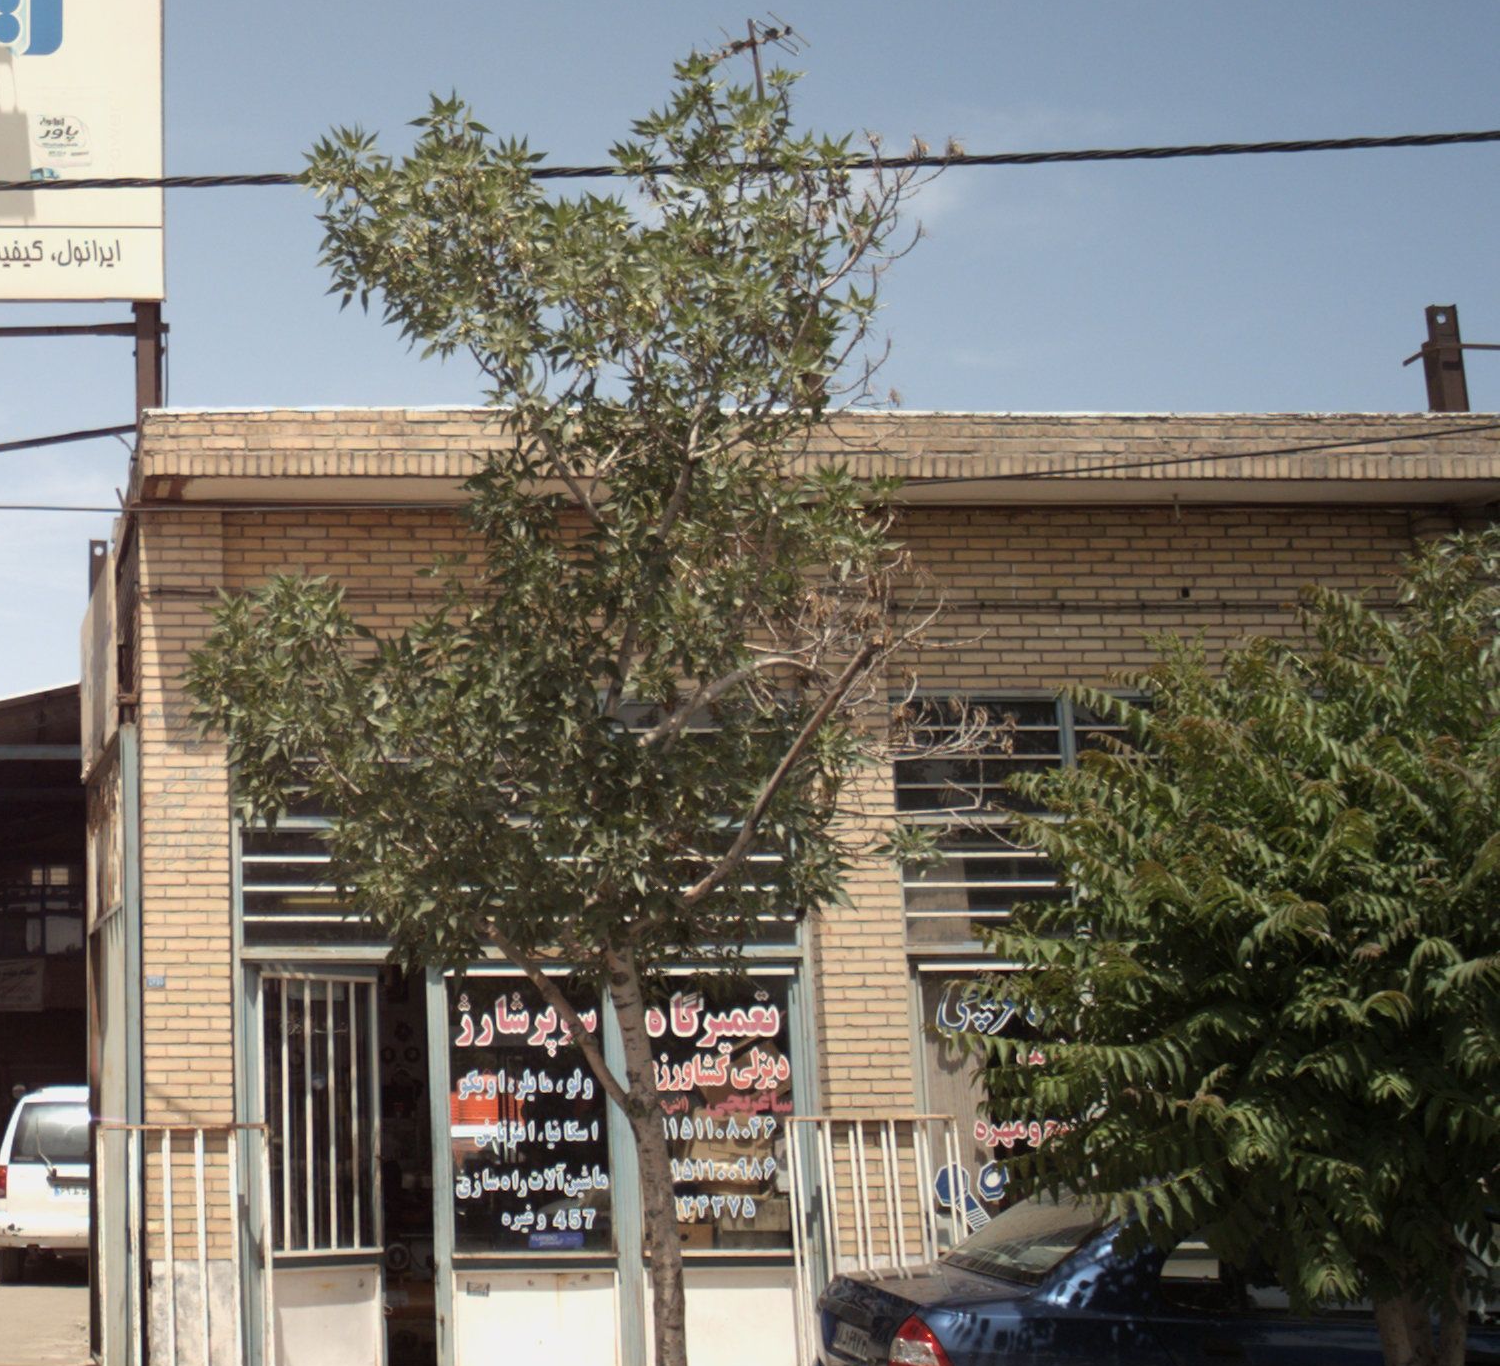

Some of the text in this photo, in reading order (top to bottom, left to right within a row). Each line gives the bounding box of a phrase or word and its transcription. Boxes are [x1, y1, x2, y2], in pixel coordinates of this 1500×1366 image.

[38, 125, 79, 142] پاور
[644, 990, 781, 1047] تعمیرگاه
[730, 1046, 790, 1090] دیزلی
[564, 1165, 609, 1198] ماشین
[553, 1208, 596, 1230] 457
